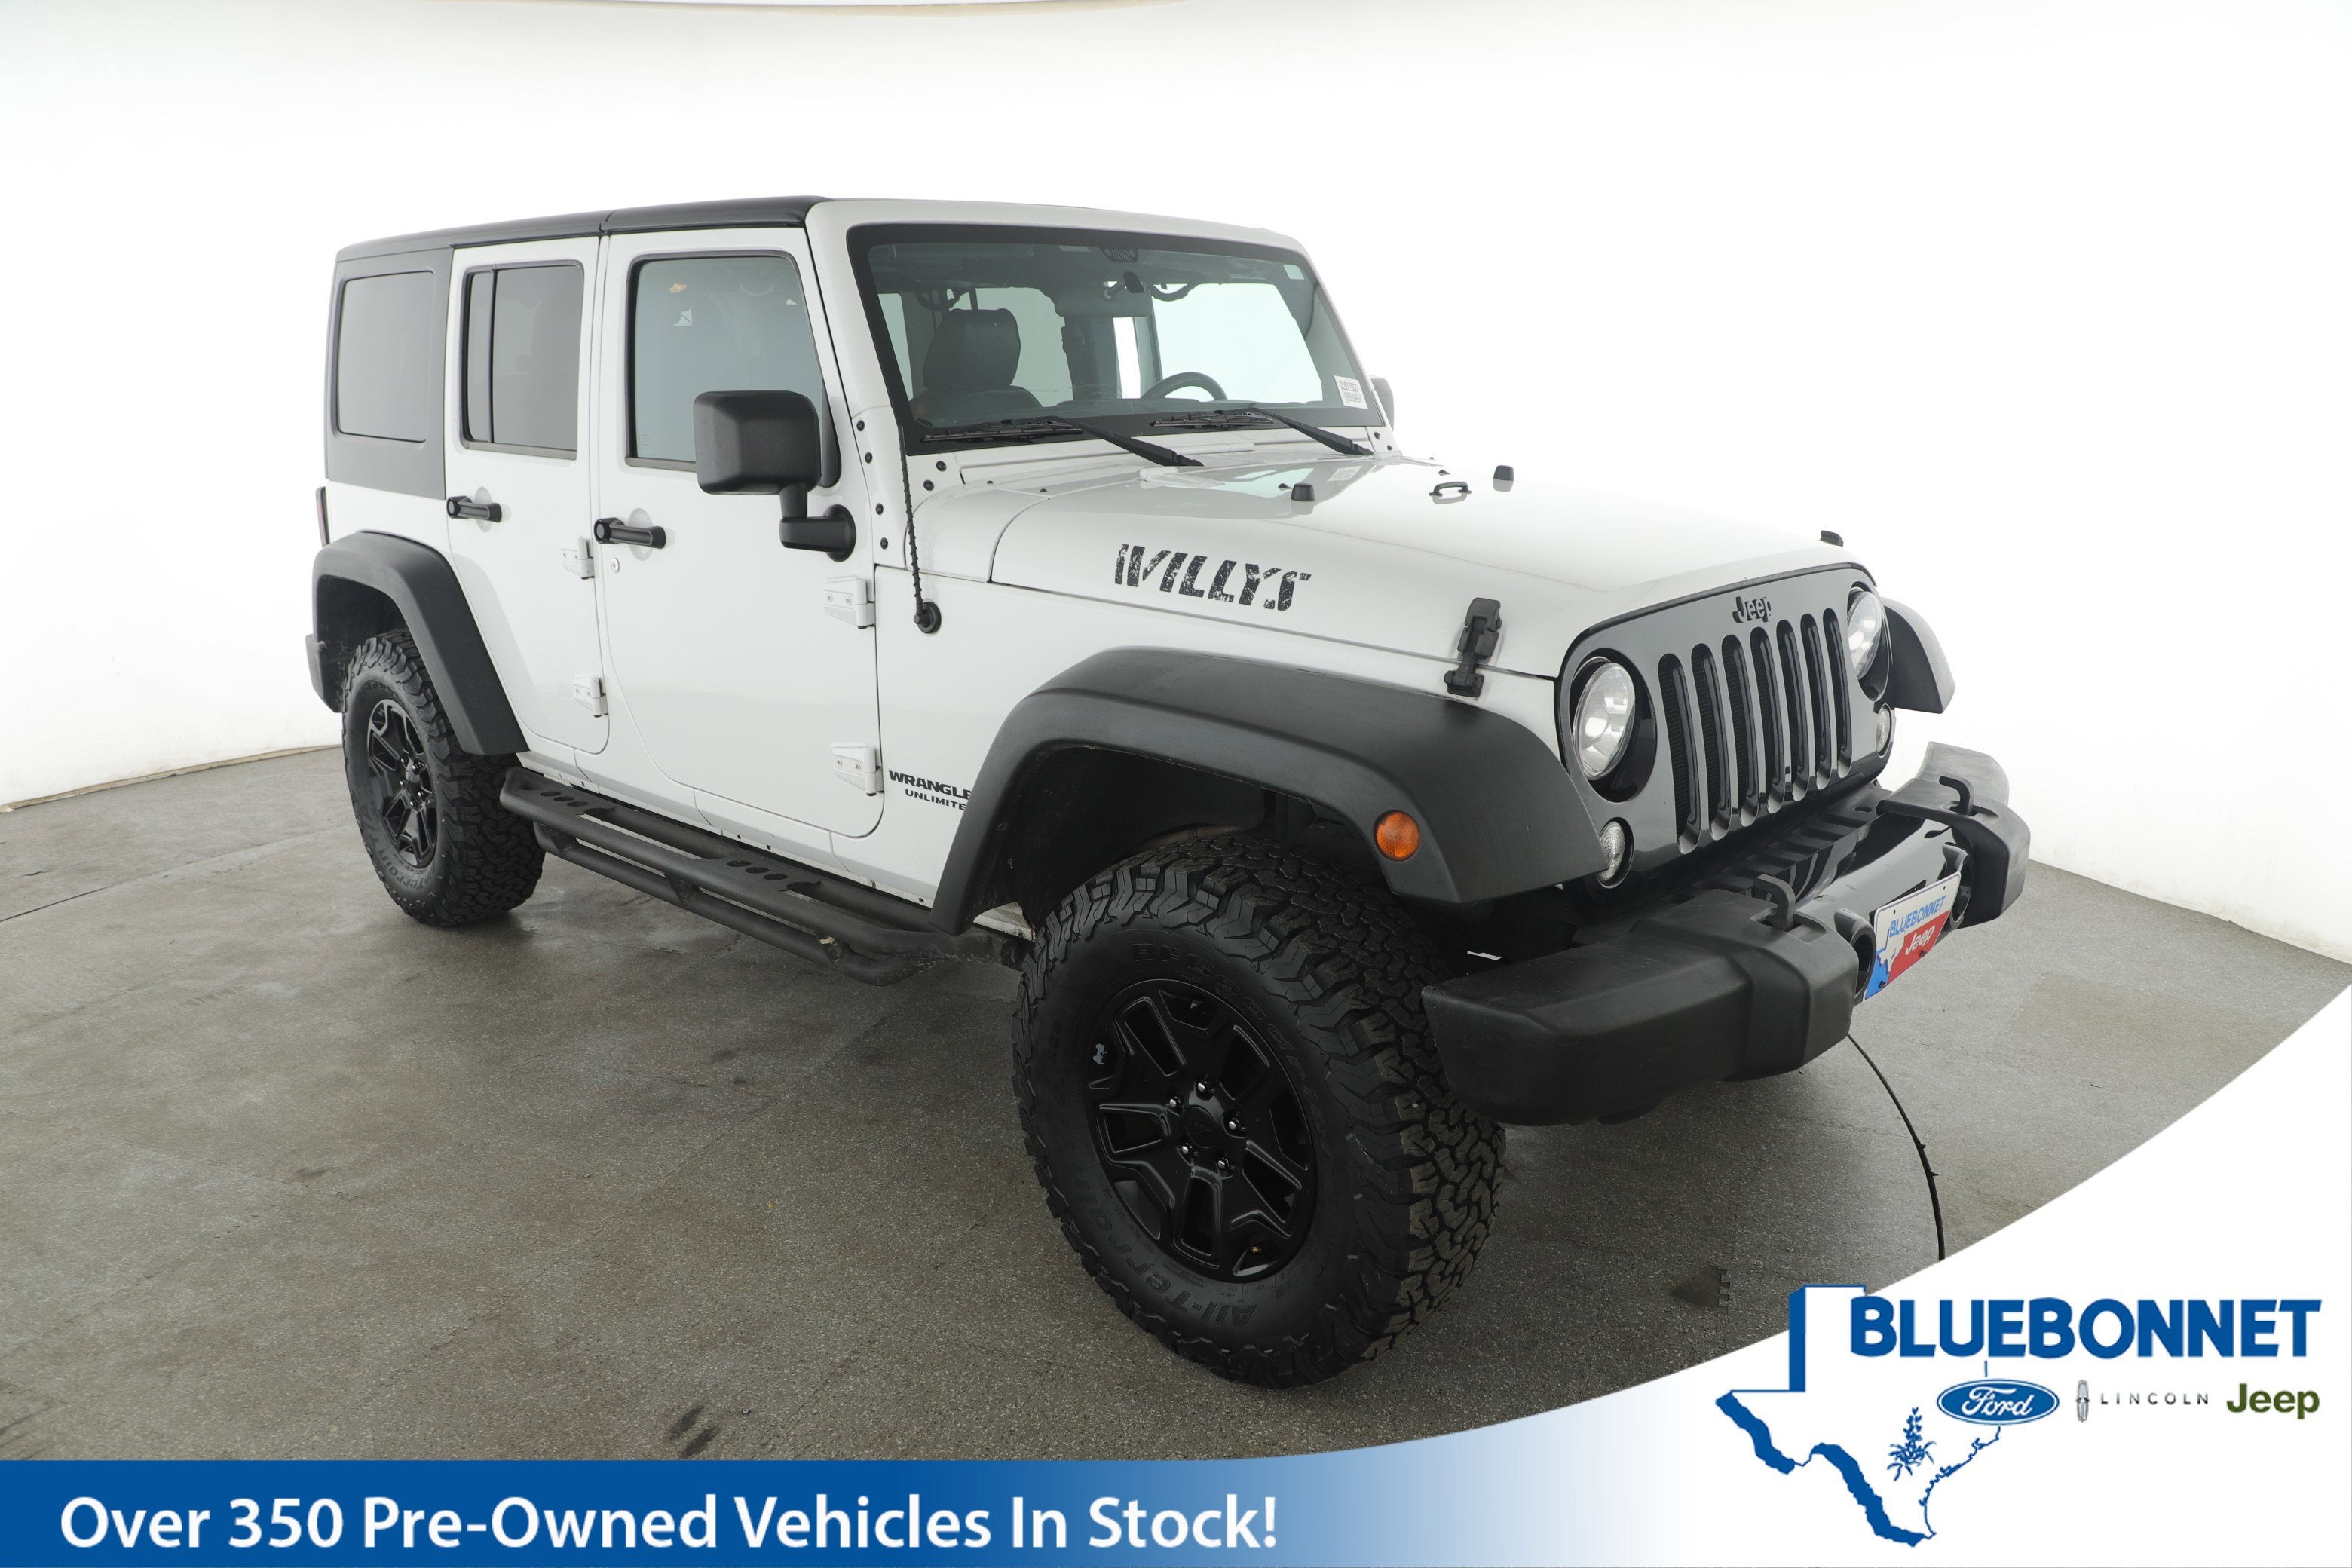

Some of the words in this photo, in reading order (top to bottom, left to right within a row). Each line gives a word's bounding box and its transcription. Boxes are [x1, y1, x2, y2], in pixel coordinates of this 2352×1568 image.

[1115, 544, 1312, 611] WILLYS
[1732, 596, 1772, 623] Jeep
[1888, 895, 1946, 938] BLUEBONNET
[1904, 925, 1936, 956] Jeep
